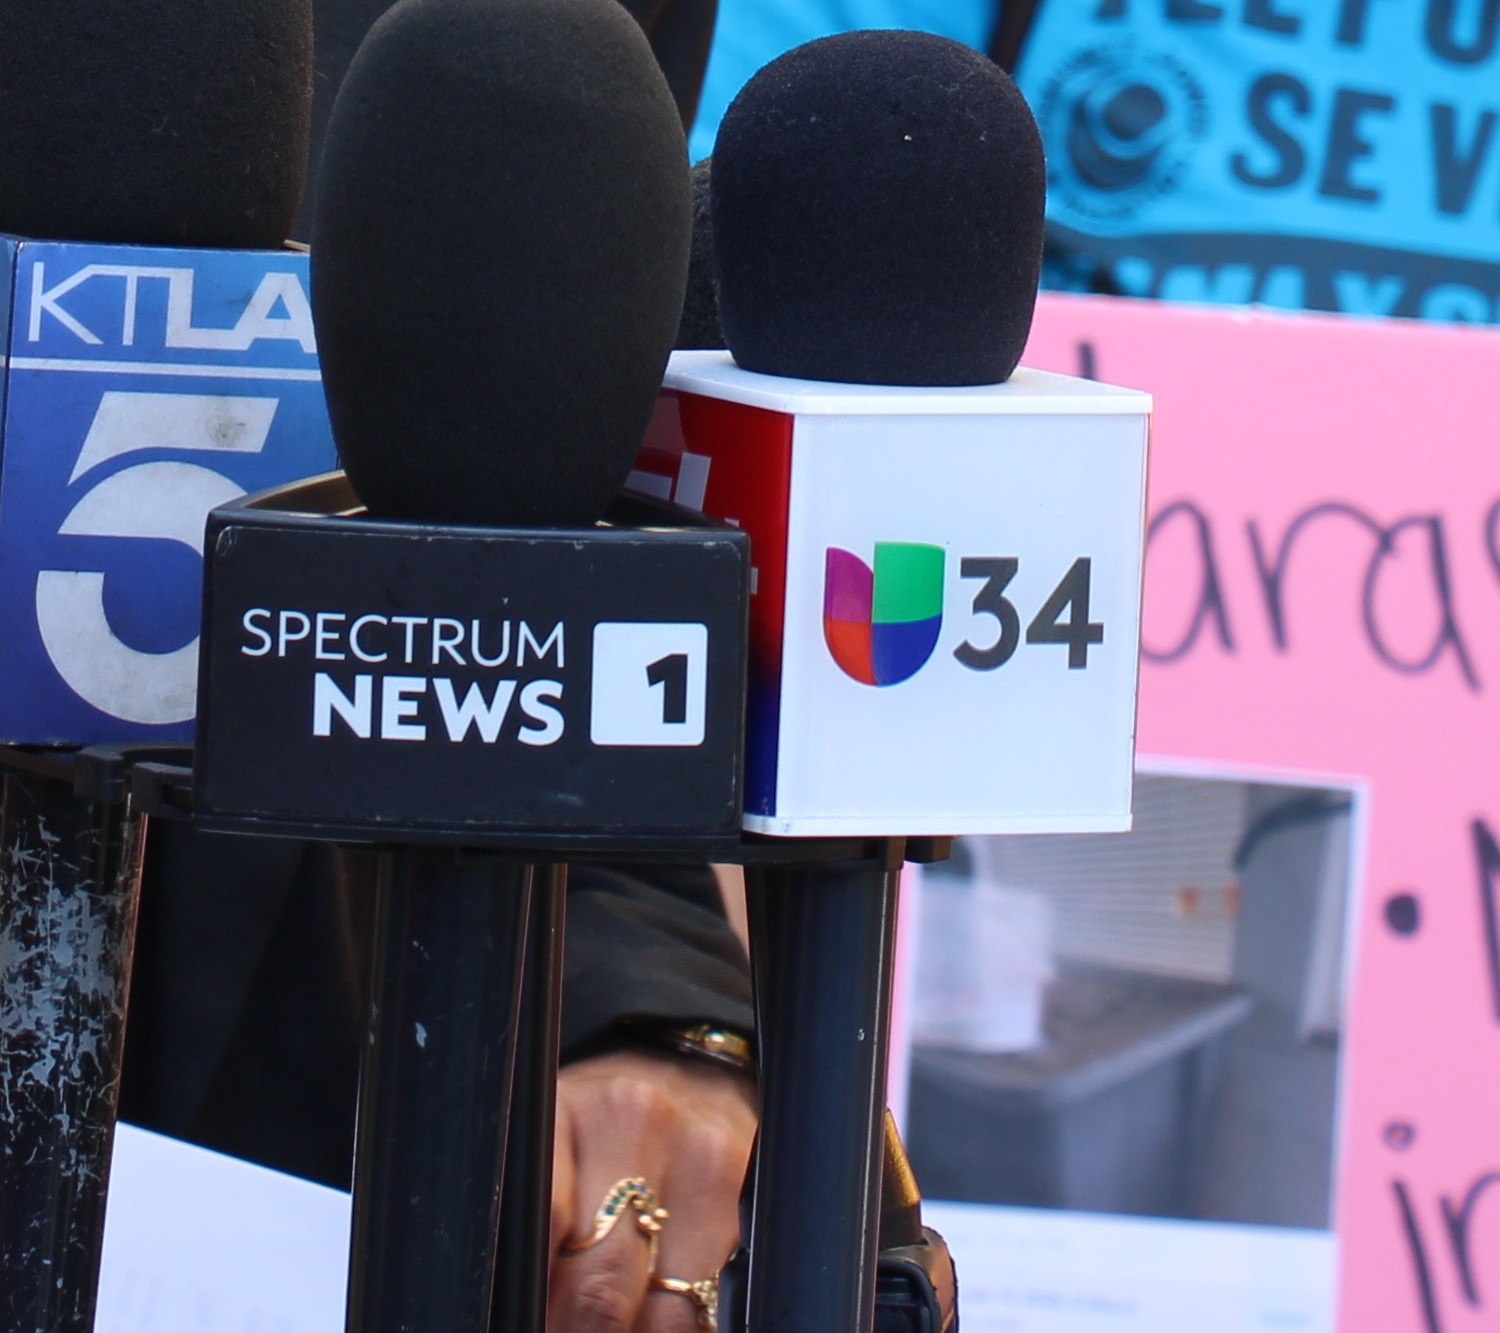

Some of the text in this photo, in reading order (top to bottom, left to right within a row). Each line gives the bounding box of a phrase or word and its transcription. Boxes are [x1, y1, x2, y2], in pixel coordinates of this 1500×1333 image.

[1228, 73, 1394, 204] SE
[28, 262, 318, 354] KTLA
[34, 390, 280, 725] 5
[240, 607, 566, 669] SPECTRUM
[952, 555, 1104, 673] 34
[312, 652, 690, 747] NEWS 1
